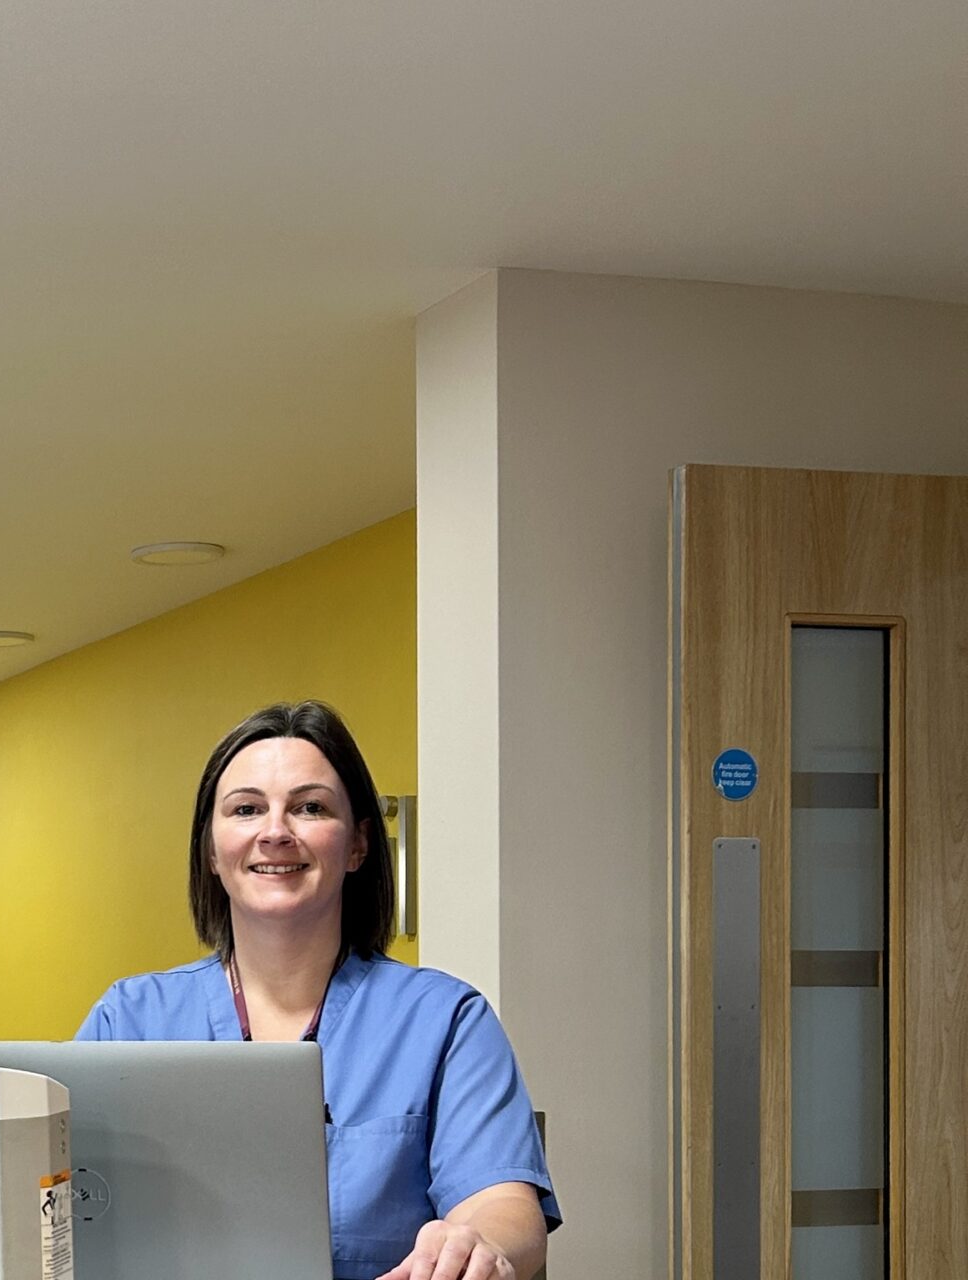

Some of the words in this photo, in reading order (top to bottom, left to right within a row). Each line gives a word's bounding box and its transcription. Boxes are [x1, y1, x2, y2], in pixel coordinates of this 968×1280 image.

[718, 762, 752, 770] Automatic
[721, 770, 732, 778] fire
[733, 770, 749, 778] door
